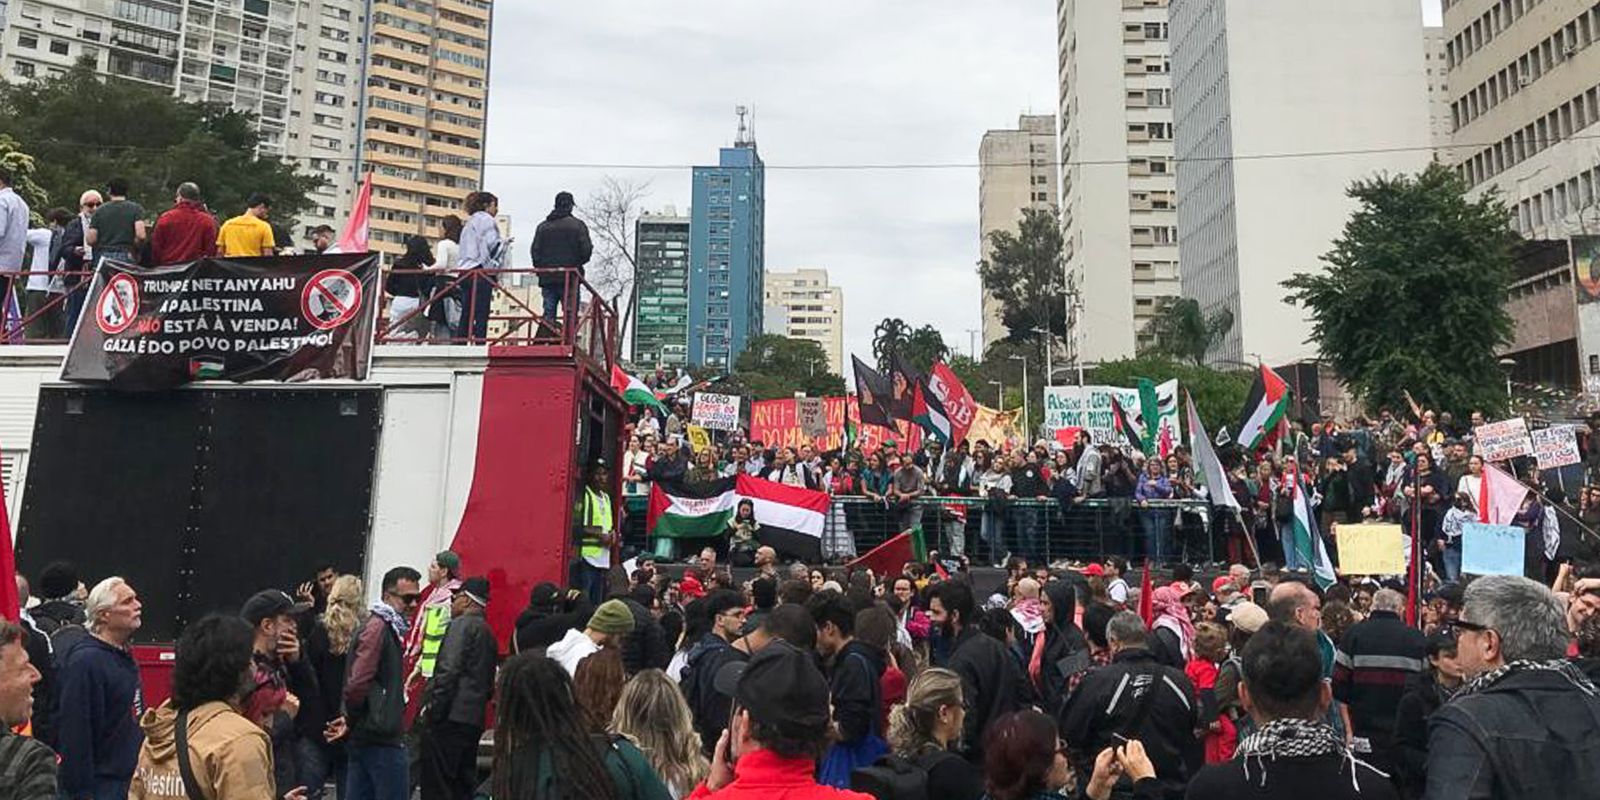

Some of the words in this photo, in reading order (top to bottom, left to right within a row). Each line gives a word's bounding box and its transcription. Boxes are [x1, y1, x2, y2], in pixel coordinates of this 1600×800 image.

[144, 280, 181, 293] TRUMP
[191, 277, 296, 292] NETANYAHU
[159, 299, 169, 313] A
[169, 297, 264, 313] PALESTINA
[163, 313, 209, 334] ESTÁ
[230, 317, 300, 333] VENDA!
[103, 338, 136, 353] GAZA
[137, 336, 147, 354] É
[148, 339, 175, 354] DO
[178, 336, 231, 354] POVO
[234, 331, 334, 352] PALESTINO!
[140, 767, 186, 797] Palestin
